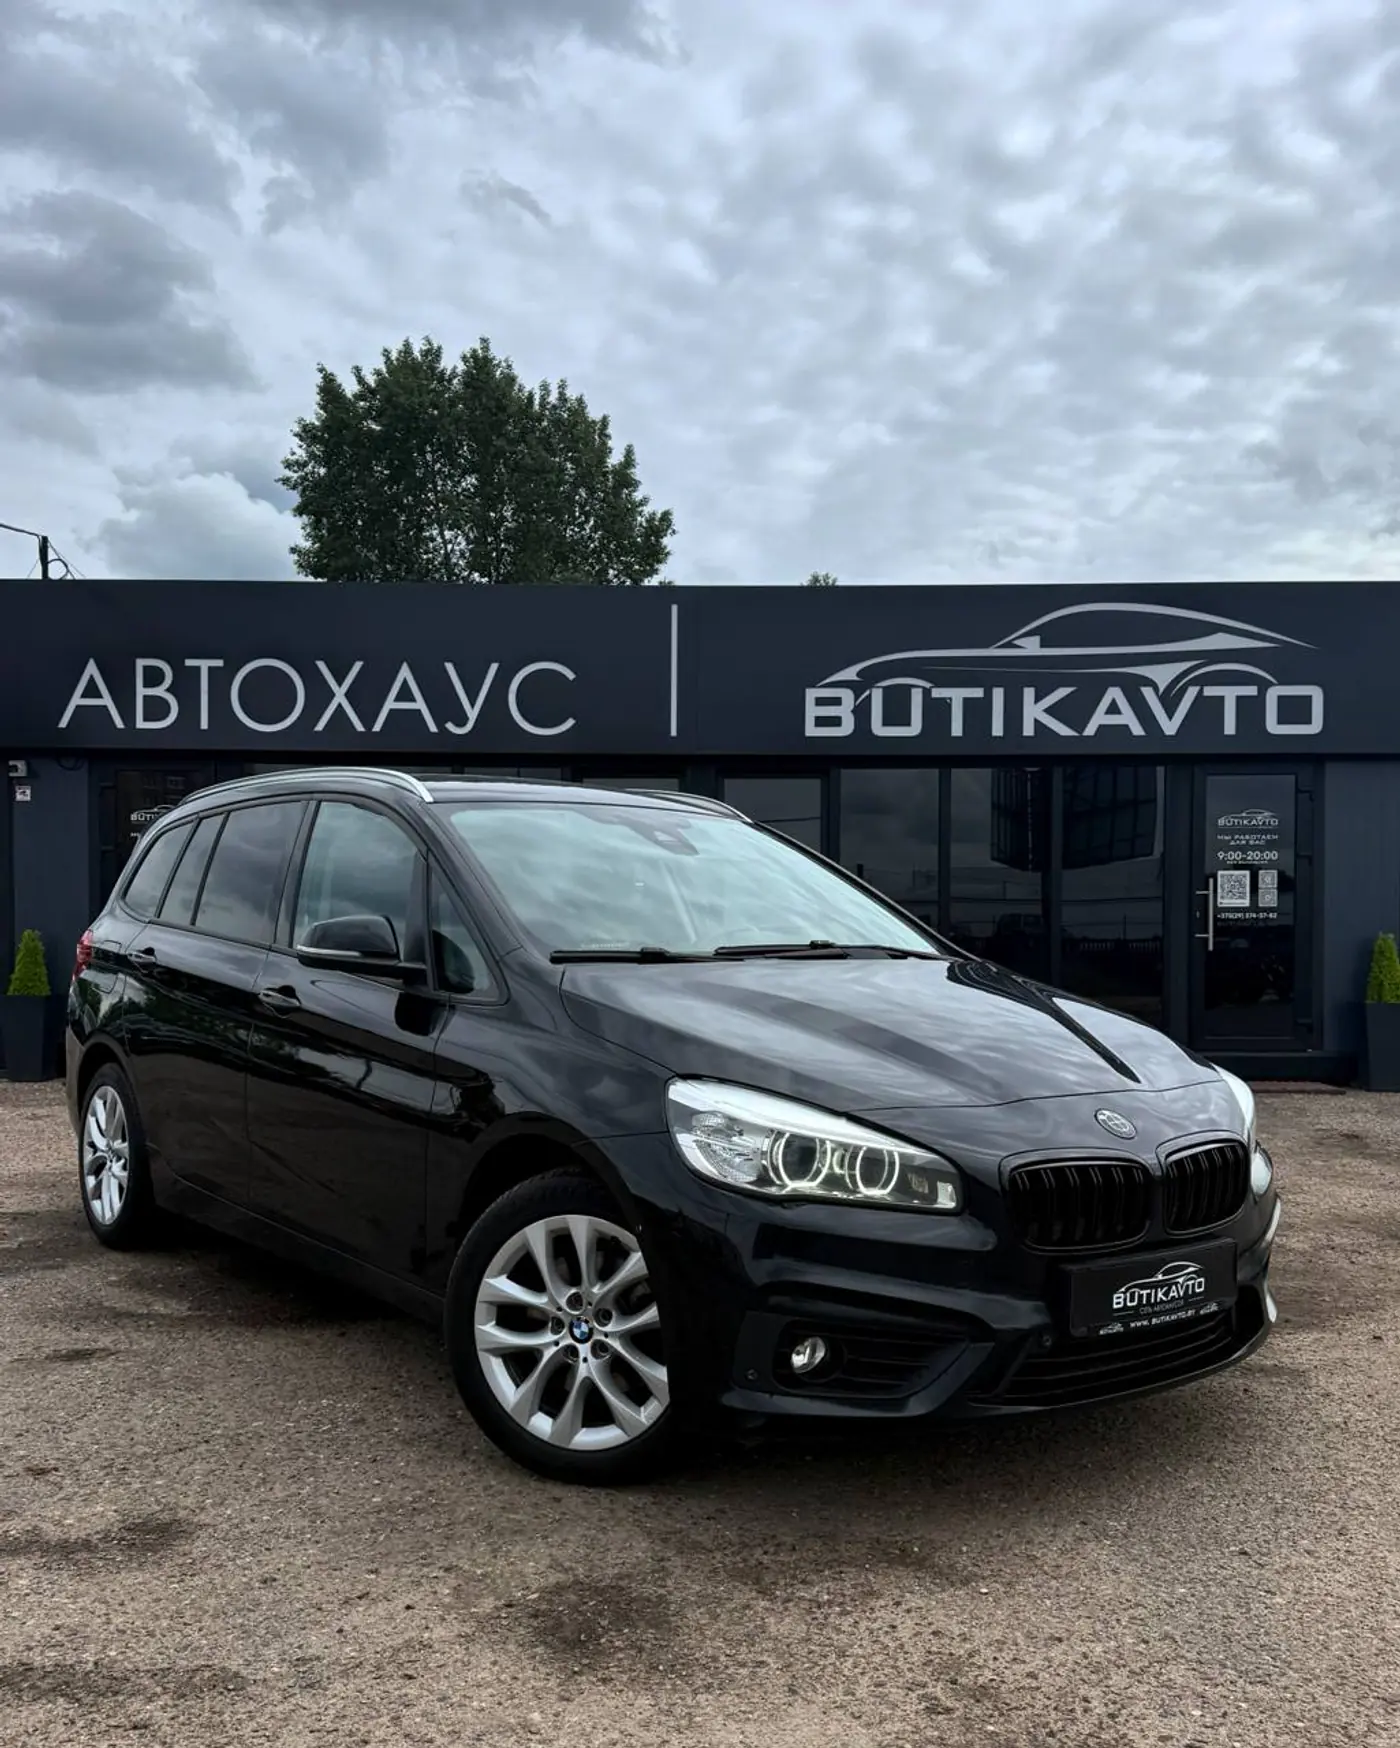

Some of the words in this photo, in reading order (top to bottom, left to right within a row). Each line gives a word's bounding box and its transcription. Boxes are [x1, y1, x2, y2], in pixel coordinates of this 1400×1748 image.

[58, 657, 577, 736] АВТОХАУС
[805, 684, 1324, 737] BUTIKAVTO
[1218, 818, 1279, 826] BUTIKAVTO
[1217, 850, 1279, 861] 9:00-20:00
[1112, 1277, 1205, 1310] BUTIKAVTO
